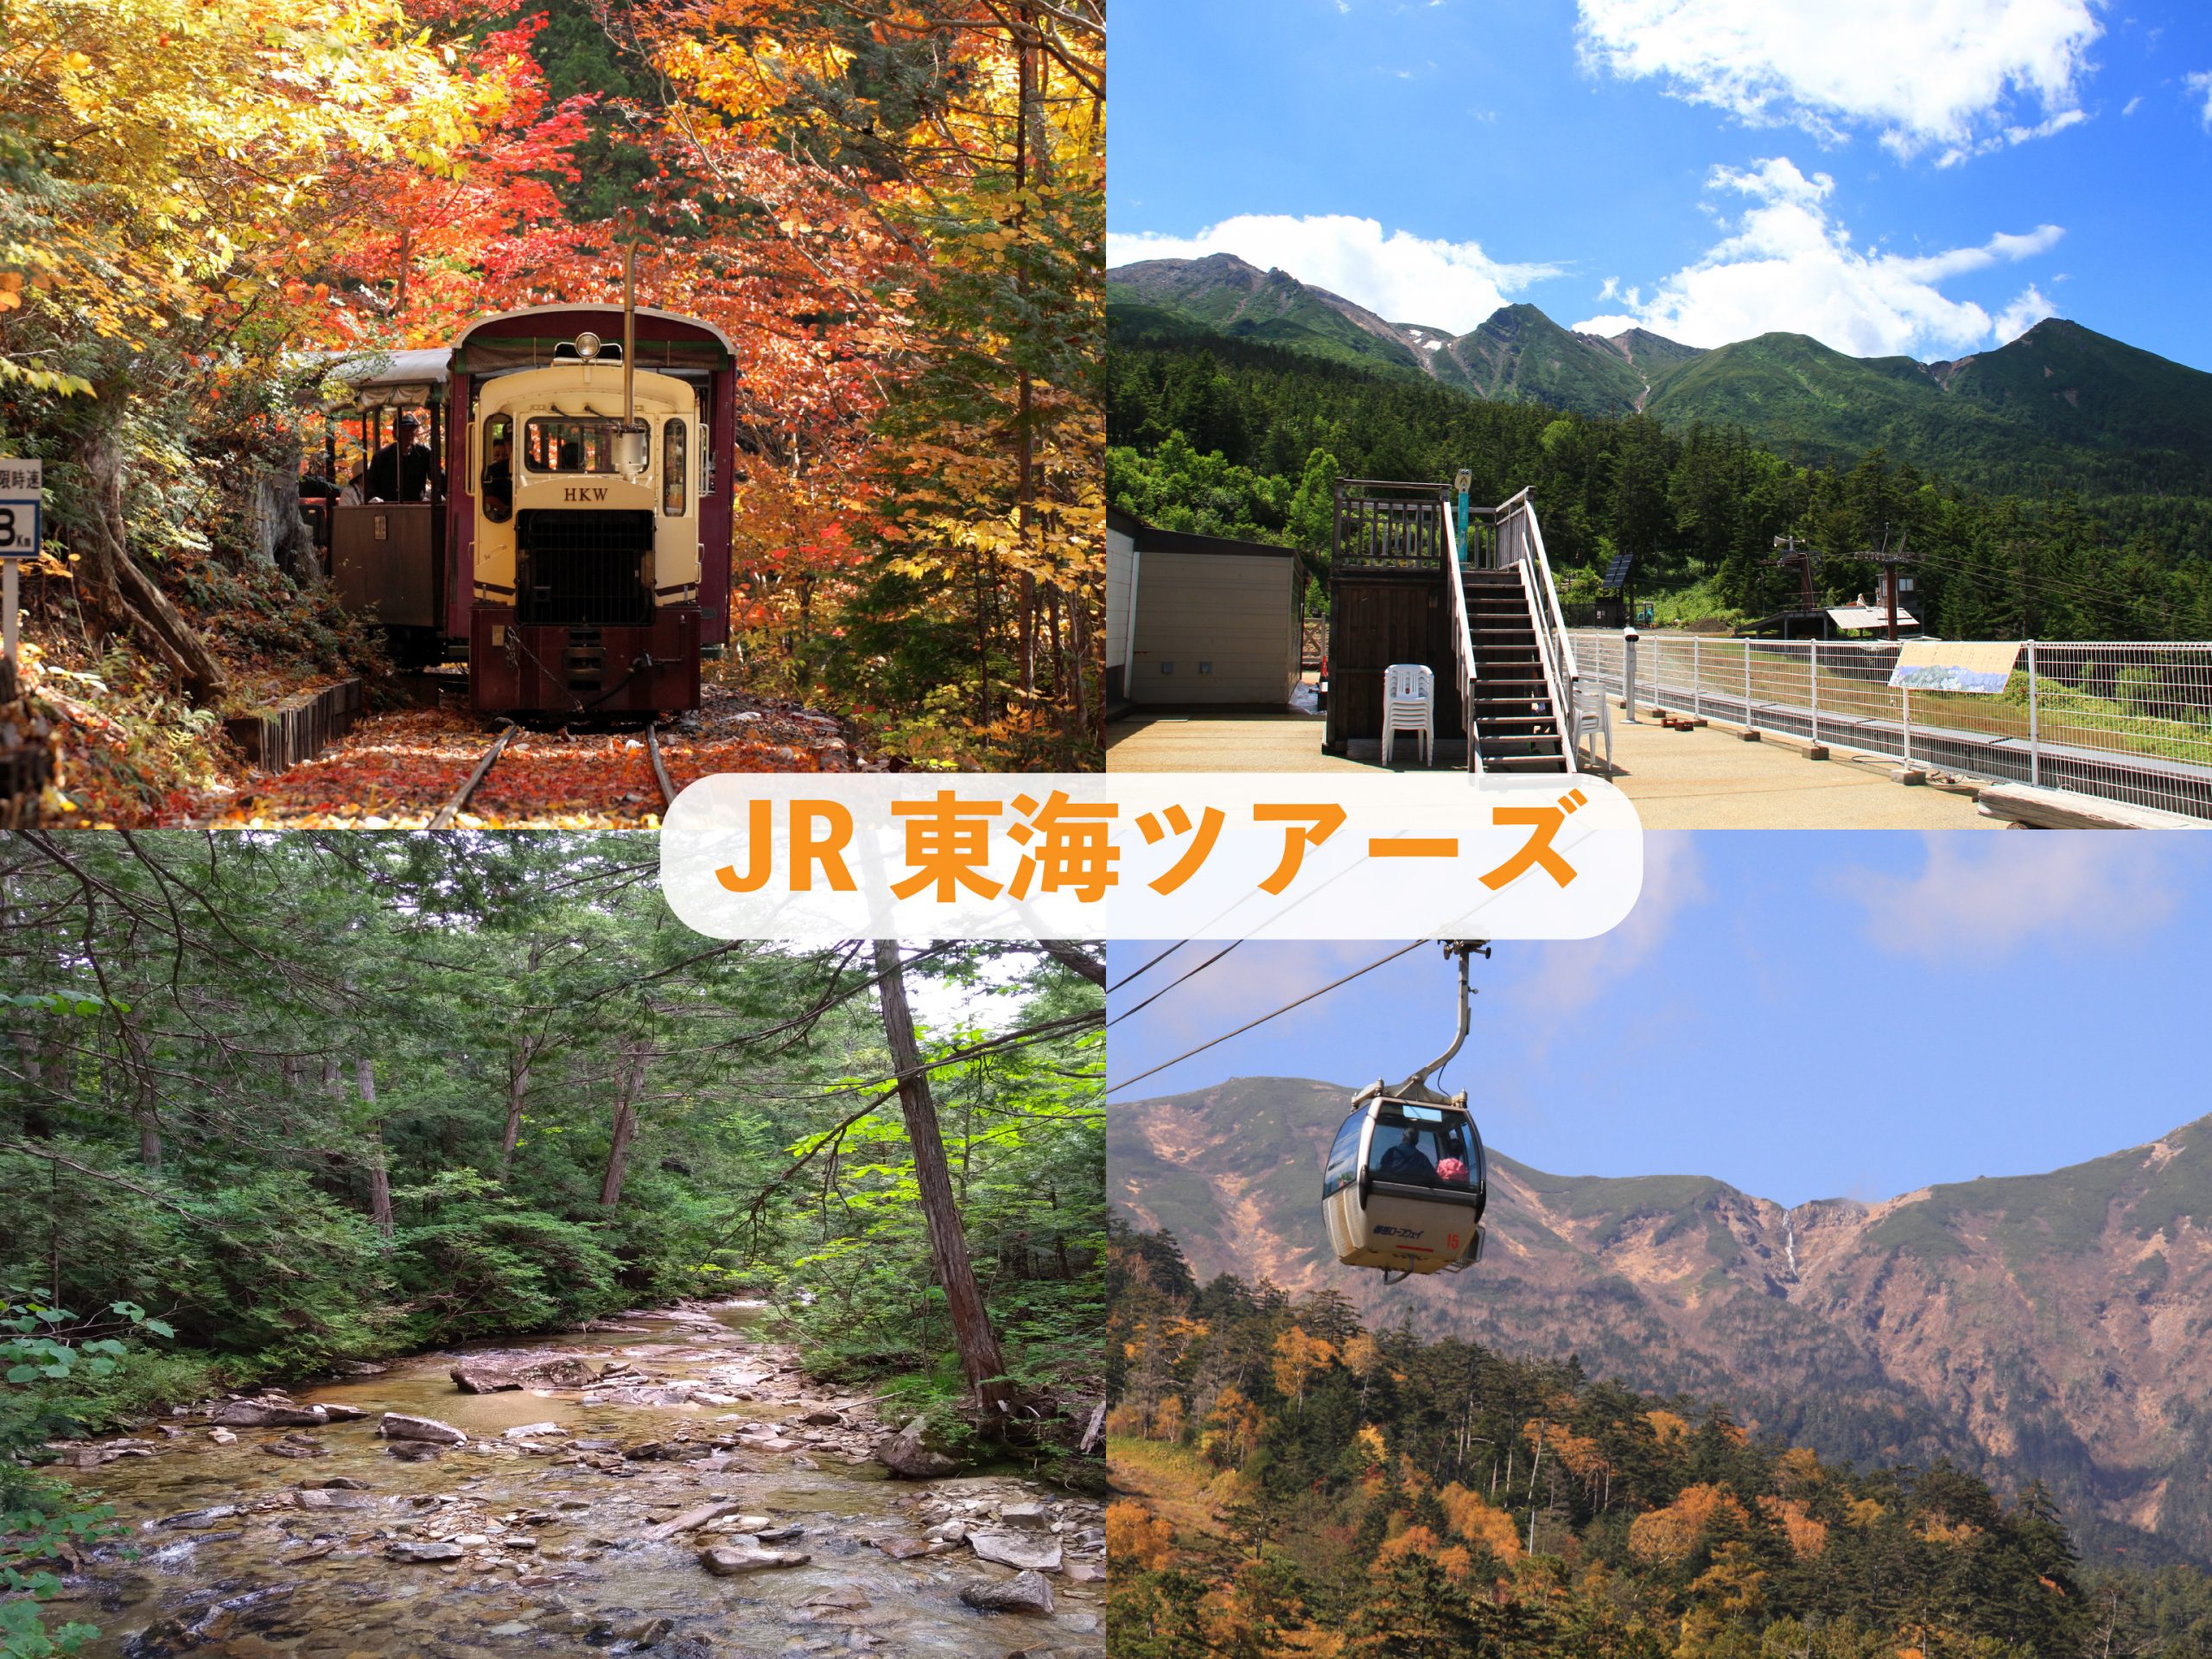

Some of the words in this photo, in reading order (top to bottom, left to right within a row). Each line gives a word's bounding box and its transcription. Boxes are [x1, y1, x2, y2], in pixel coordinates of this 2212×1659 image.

[563, 487, 609, 502] HKW
[1373, 1224, 1424, 1239] ロープウェイ
[1446, 1232, 1459, 1249] 15
